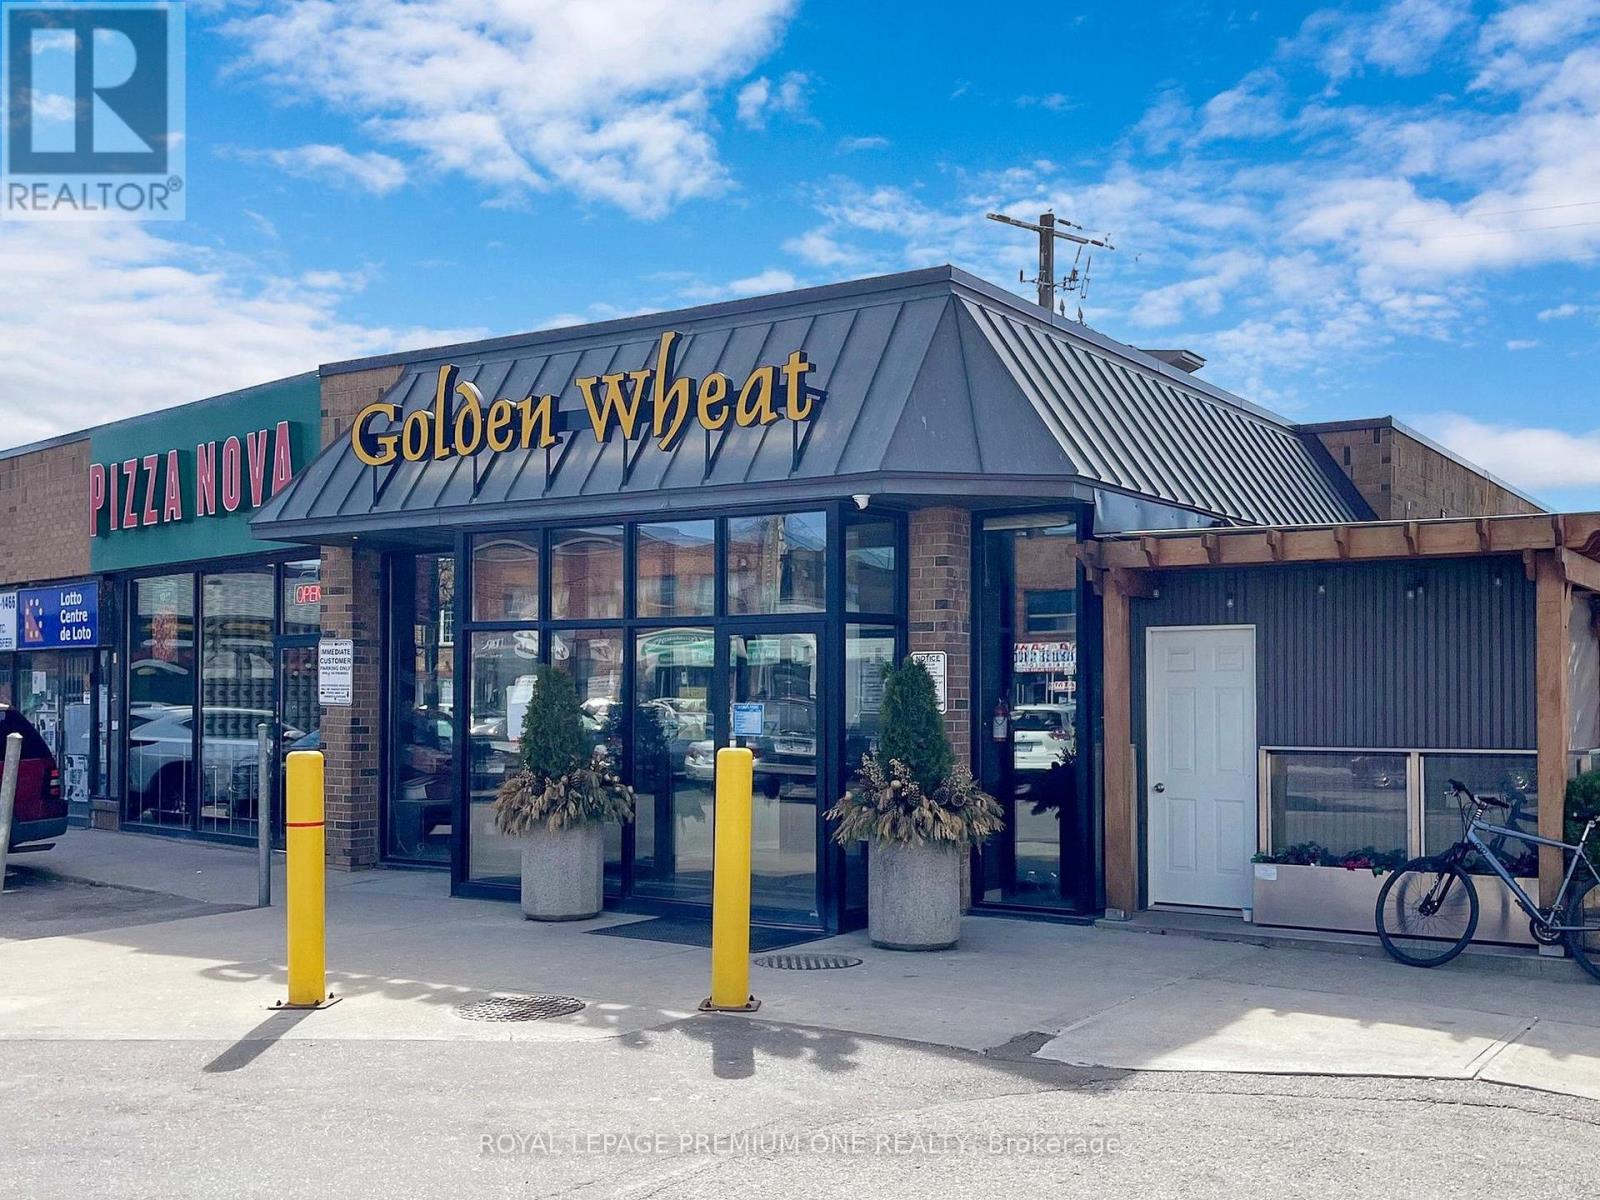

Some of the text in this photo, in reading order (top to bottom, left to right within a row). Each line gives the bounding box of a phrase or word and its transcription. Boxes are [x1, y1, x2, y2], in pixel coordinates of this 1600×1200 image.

[351, 330, 815, 466] Golden Wheat
[89, 420, 293, 537] PIZZA NOVA
[60, 591, 82, 606] Lotto
[60, 609, 88, 624] Centre
[60, 626, 92, 641] de Loto
